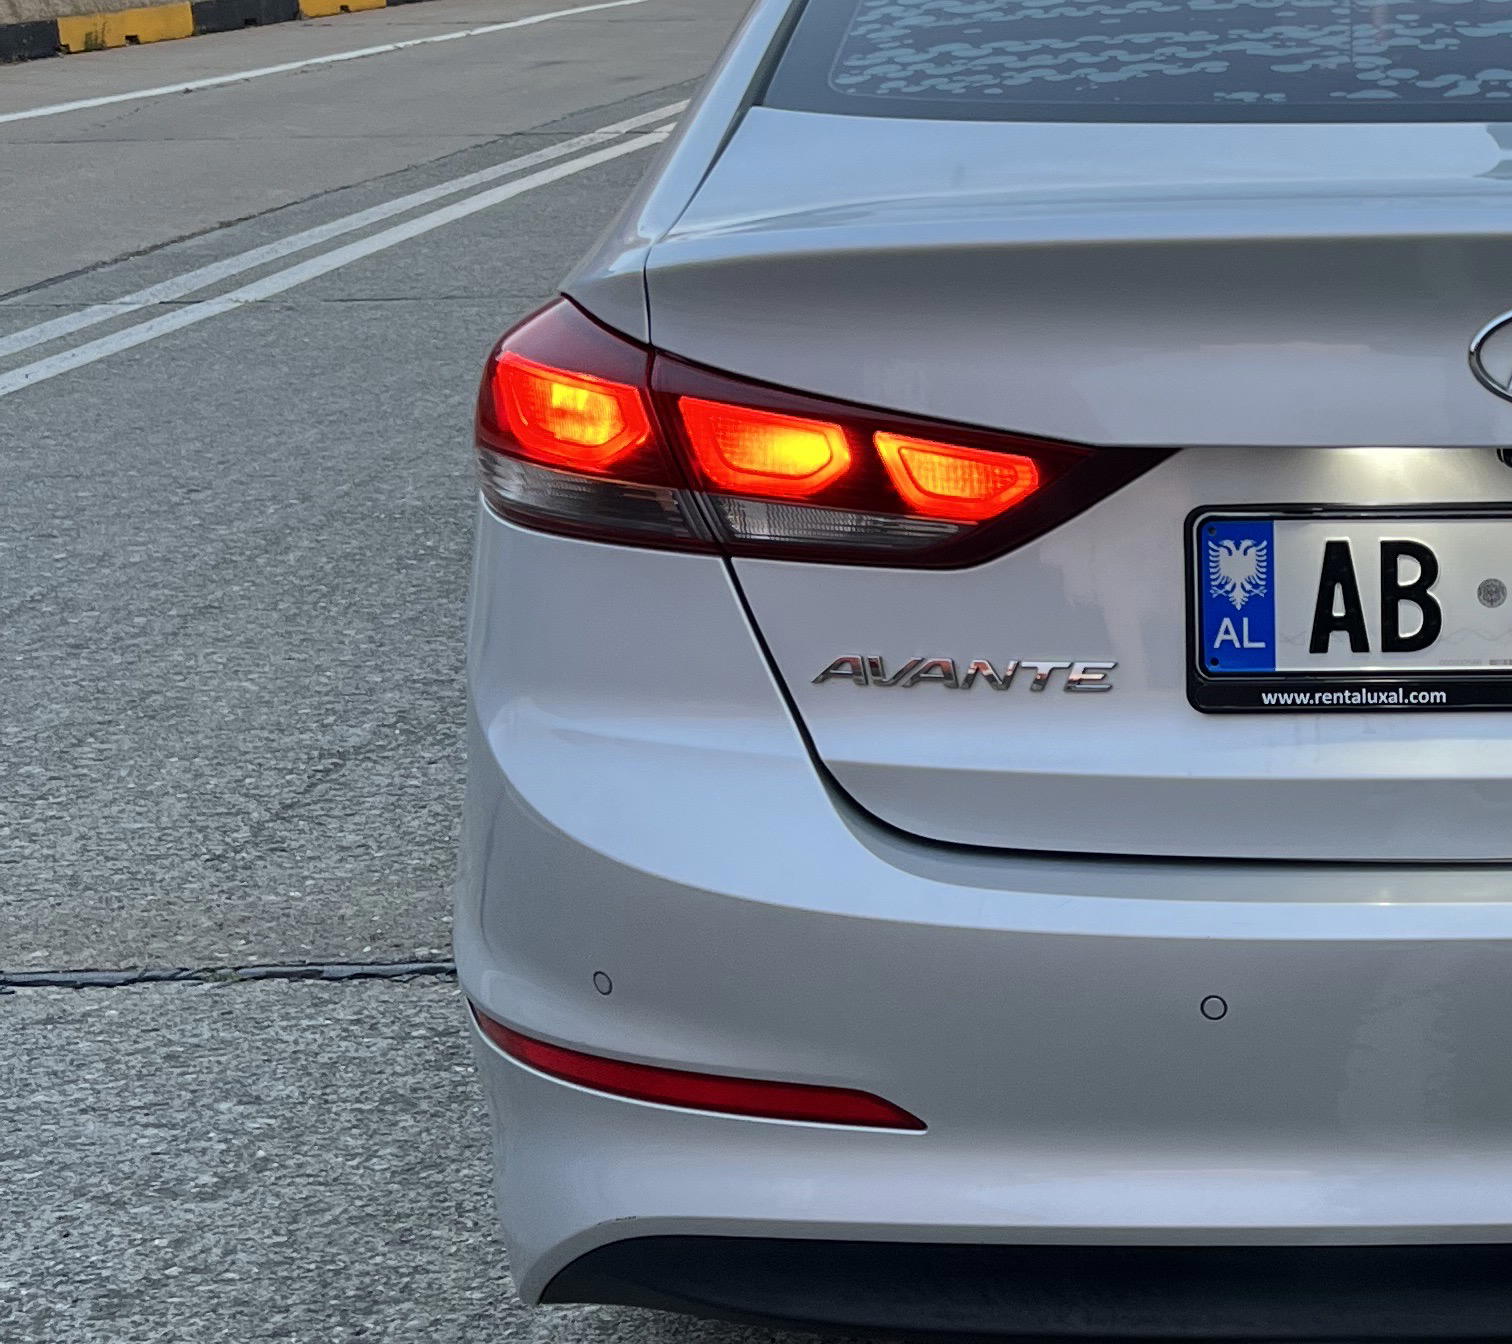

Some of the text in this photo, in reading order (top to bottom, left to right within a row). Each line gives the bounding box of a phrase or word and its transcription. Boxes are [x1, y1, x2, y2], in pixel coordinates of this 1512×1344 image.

[1308, 539, 1443, 654] AB
[1213, 618, 1267, 650] AL
[811, 654, 1119, 693] AVANTE
[1261, 688, 1447, 705] www.rentaluxal.com
